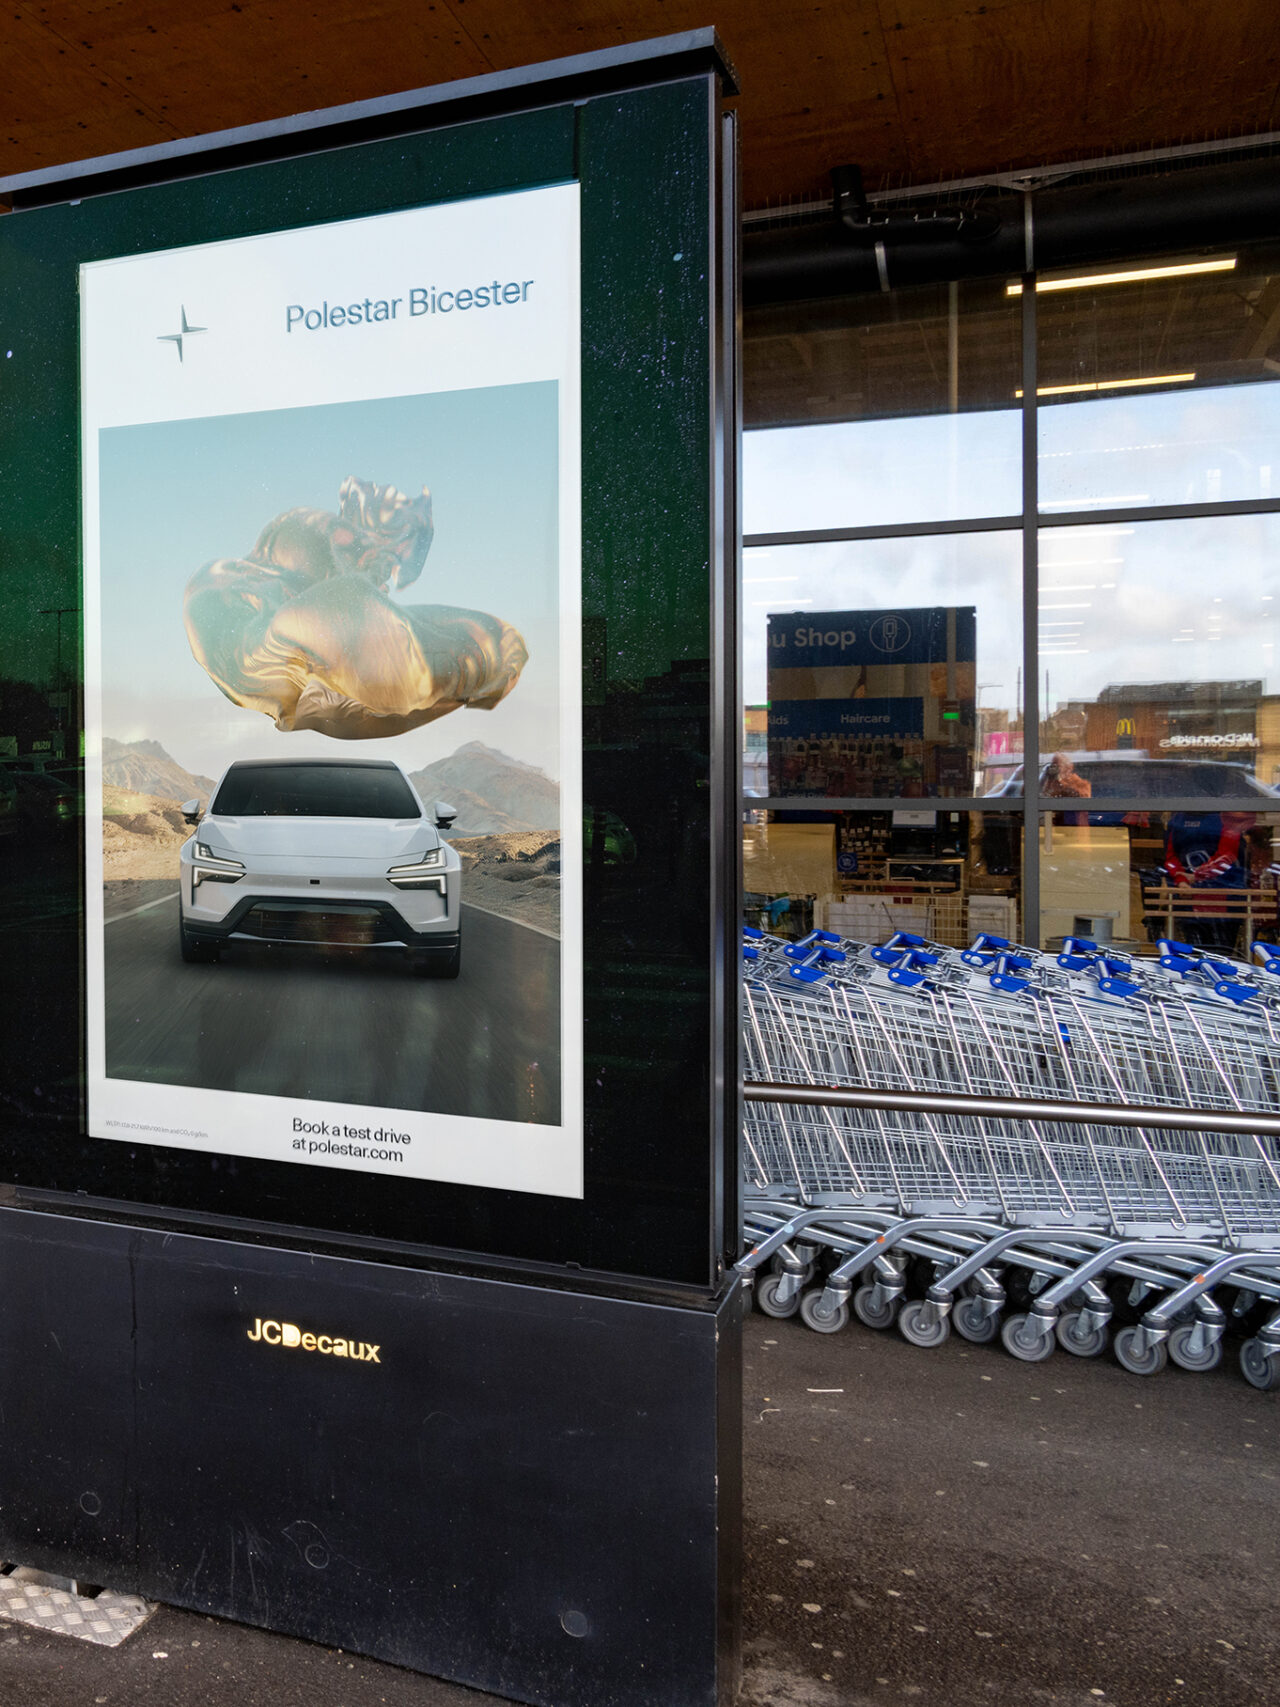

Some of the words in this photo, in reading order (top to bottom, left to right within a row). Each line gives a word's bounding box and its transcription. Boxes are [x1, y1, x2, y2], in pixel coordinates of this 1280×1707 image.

[286, 297, 402, 332] Polestar
[408, 280, 534, 317] Bicester
[794, 627, 856, 650] Shop
[840, 713, 891, 724] Haircare
[292, 1117, 330, 1136] Book
[332, 1125, 341, 1137] a
[343, 1125, 371, 1141] test
[374, 1127, 412, 1145] drive
[292, 1138, 306, 1150] at
[309, 1140, 404, 1162] polestar.com
[247, 1318, 381, 1364] JCDecaux
